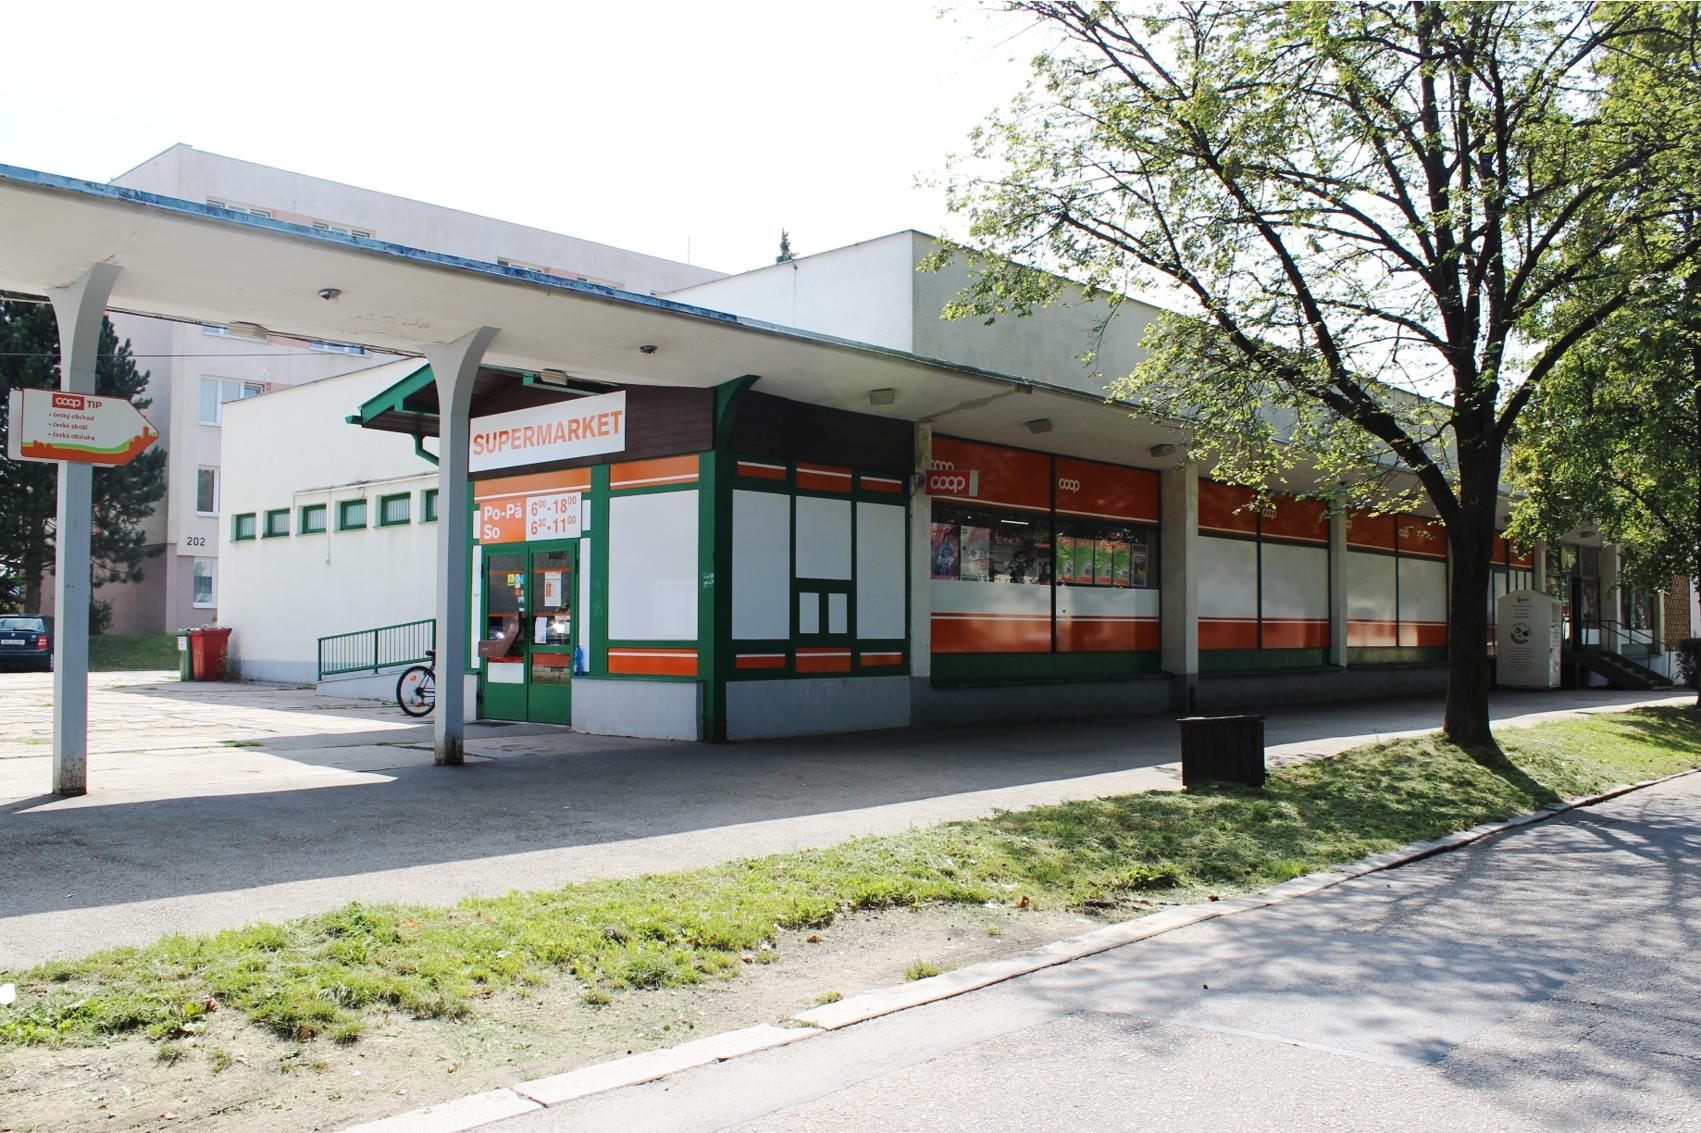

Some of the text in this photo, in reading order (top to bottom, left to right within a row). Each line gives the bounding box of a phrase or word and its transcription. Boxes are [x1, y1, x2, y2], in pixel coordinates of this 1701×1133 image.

[55, 397, 102, 409] coop TIP
[71, 413, 95, 422] obchod
[473, 410, 622, 456] SUPERMARKET
[930, 476, 965, 494] coop
[1058, 477, 1080, 494] coop
[484, 502, 523, 521] Po-Pá
[483, 523, 500, 540] So
[186, 536, 206, 547] 202
